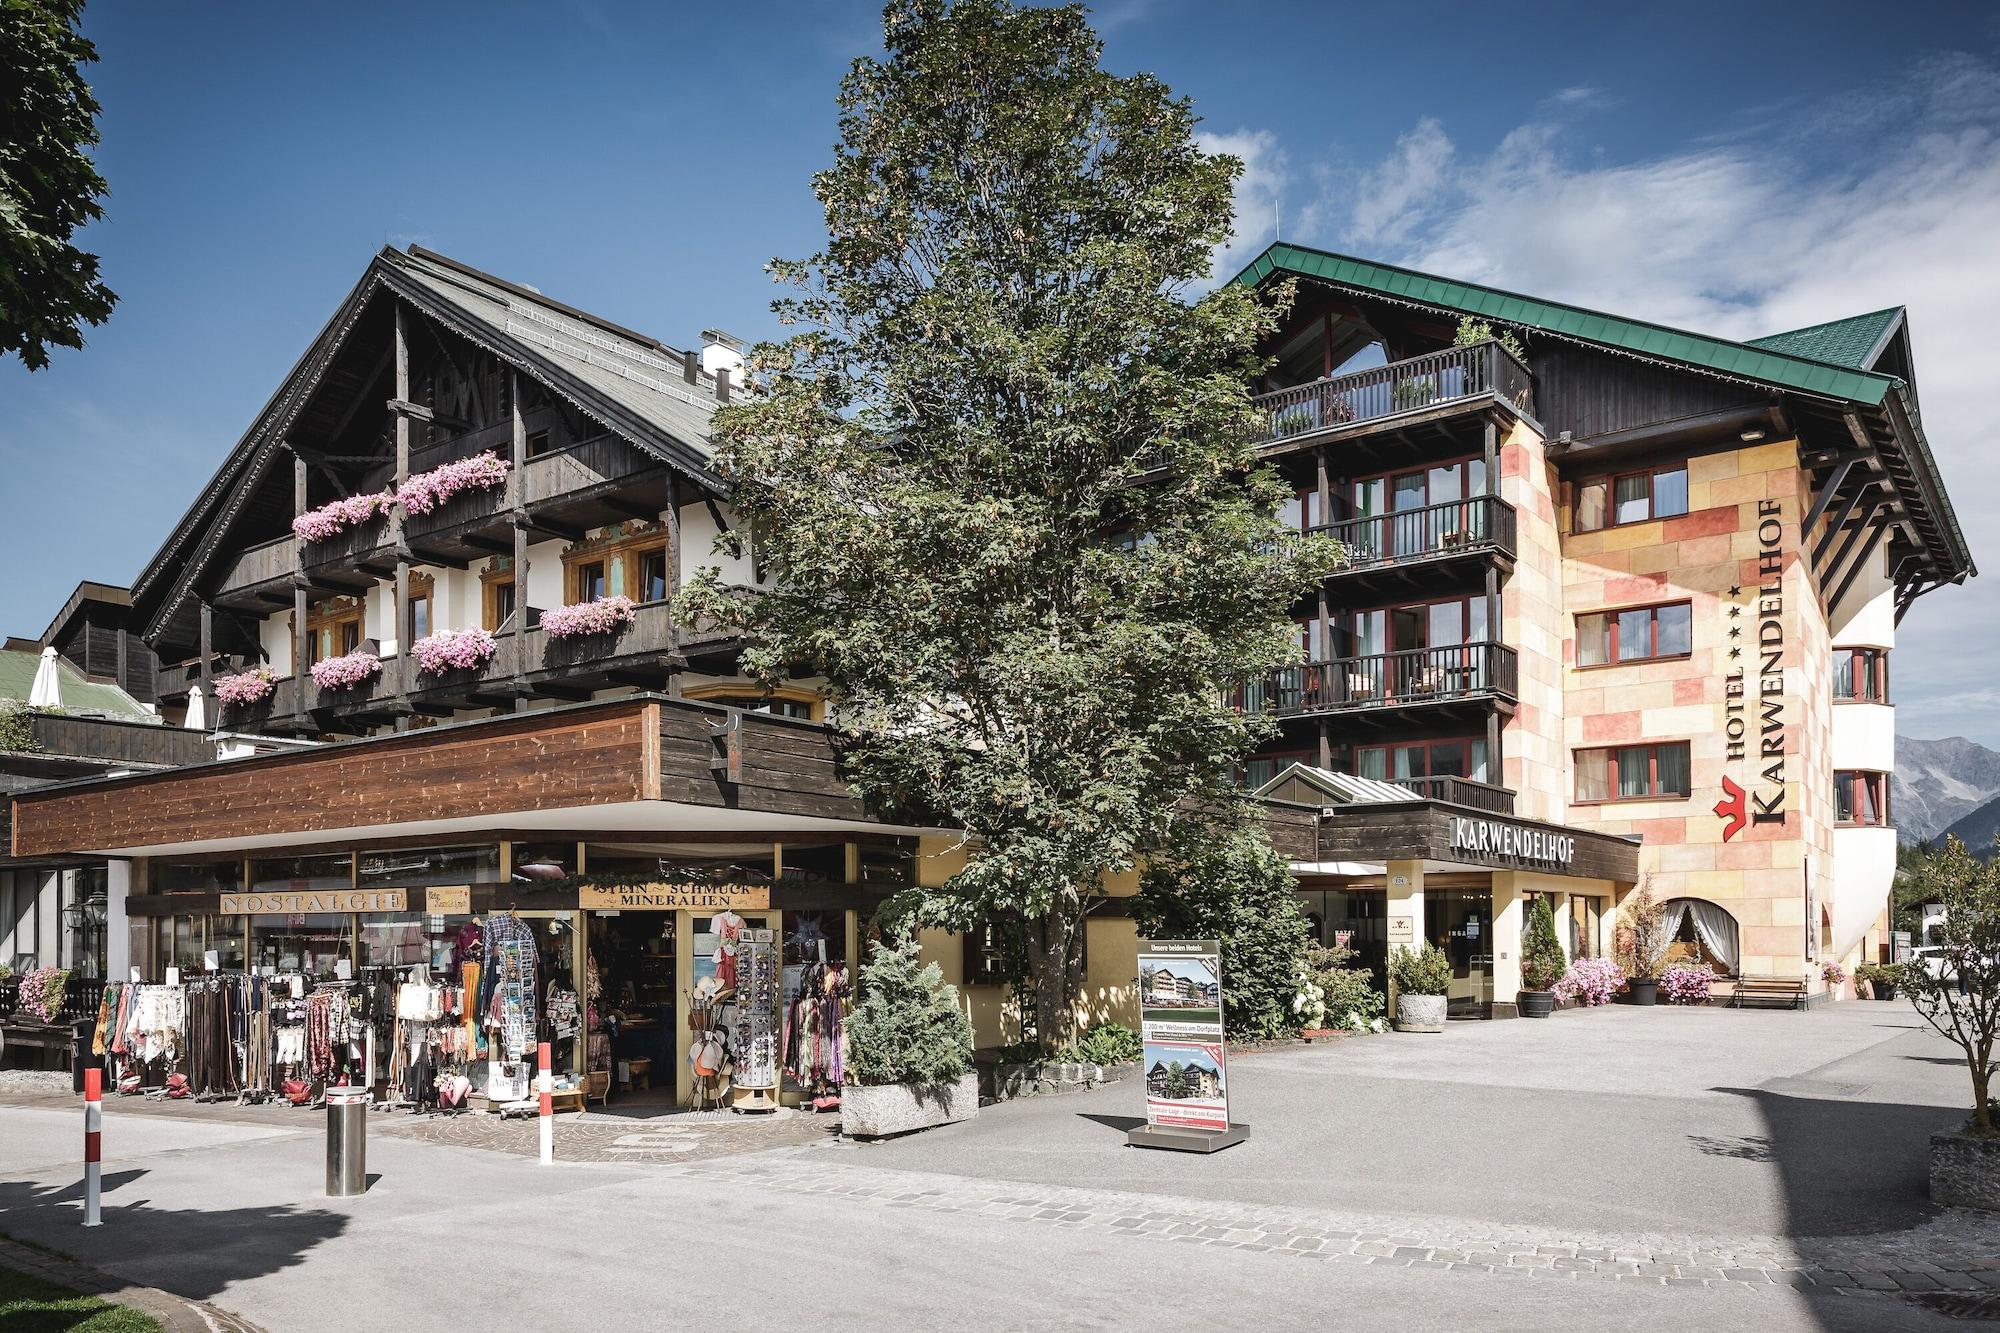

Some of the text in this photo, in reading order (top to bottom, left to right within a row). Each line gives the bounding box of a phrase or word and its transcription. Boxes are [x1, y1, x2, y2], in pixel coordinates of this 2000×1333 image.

[1752, 499, 1785, 828] KARWENDELHOF
[1726, 666, 1745, 762] HOTEL
[1456, 817, 1575, 863] KARWENDELHOF
[598, 883, 750, 895] STEIN SCHMUCK
[223, 892, 405, 913] NOSTALGIE
[620, 894, 731, 906] MINERALIEN
[1150, 944, 1202, 952] Unsere beiden Hotels
[1166, 1024, 1188, 1032] Wellness
[1196, 1025, 1220, 1033] Dorfplatz
[1168, 1107, 1180, 1116] Lage
[1206, 1111, 1225, 1119] Kurpark
